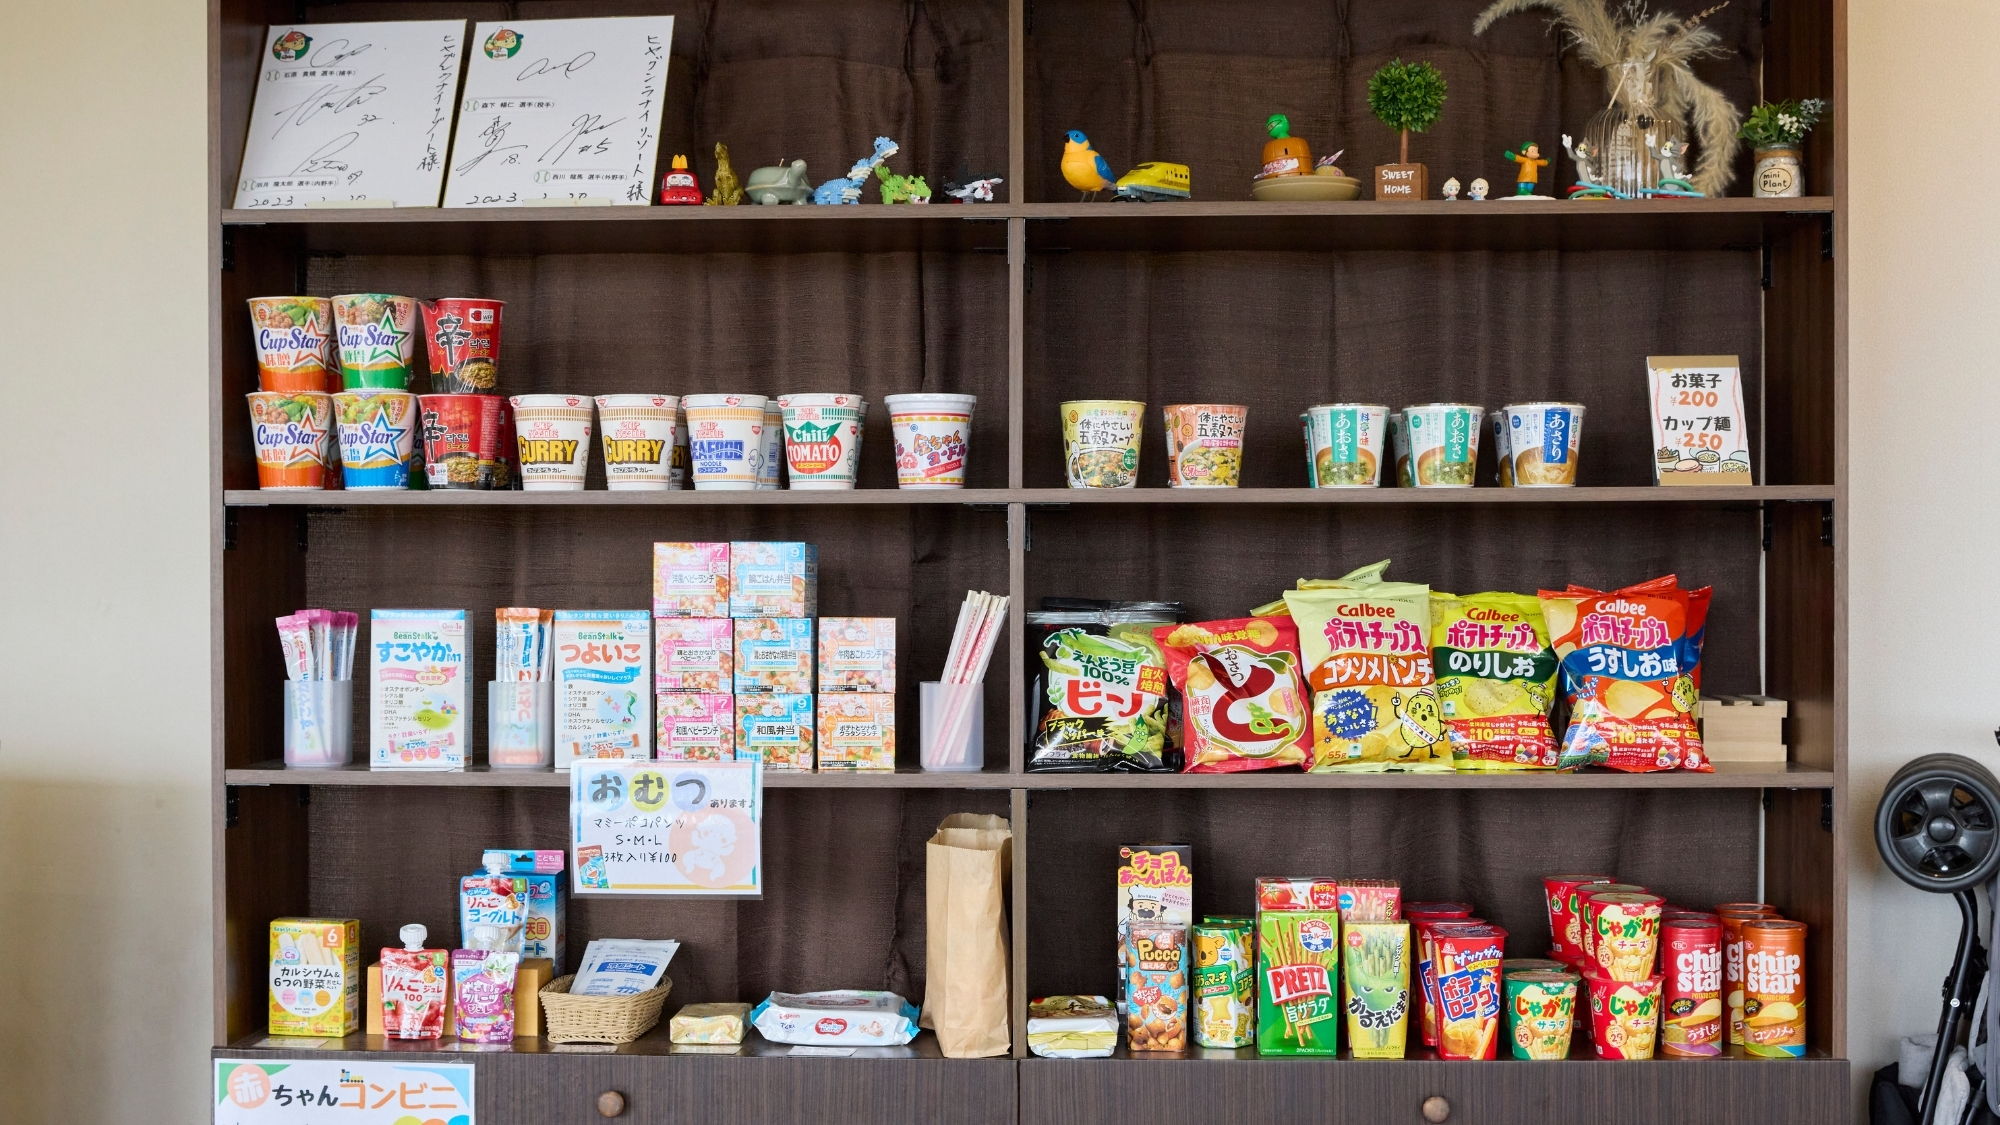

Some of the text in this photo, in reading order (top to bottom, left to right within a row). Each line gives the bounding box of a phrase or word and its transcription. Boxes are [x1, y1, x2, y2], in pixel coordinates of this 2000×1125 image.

[1382, 169, 1414, 181] SWEET
[1763, 172, 1781, 180] mini
[1384, 184, 1412, 195] HOME
[1763, 179, 1788, 190] Plant
[260, 327, 321, 352] Cup Star
[340, 325, 398, 349] Cup Star
[435, 312, 473, 367] 辛
[1671, 373, 1722, 388] お菓子
[1670, 391, 1718, 407] ¥200
[1079, 418, 1133, 430] 体にやさしい
[1197, 412, 1244, 424] 体にやさしい
[1663, 416, 1731, 431] カップ麺
[257, 423, 318, 447] Cup Star
[358, 423, 393, 445] Star
[423, 408, 448, 461] 辛
[792, 426, 830, 443] Chili
[1079, 431, 1134, 446] 五穀スープ
[1335, 412, 1352, 460] あおさ
[1449, 412, 1465, 459] あおさ
[1550, 413, 1565, 461] あさり
[1675, 432, 1723, 450] ¥250
[518, 435, 579, 464] CURRY
[604, 435, 665, 464] CURRY
[690, 435, 744, 462] SEAFOOD
[788, 443, 839, 462] TOMATO
[714, 547, 724, 557] 7
[791, 547, 799, 558] 9
[1337, 603, 1395, 618] Calbee
[1467, 608, 1519, 622] Calbee
[1595, 600, 1646, 616] Calbee
[393, 631, 432, 640] BeanStalk
[578, 631, 617, 640] BeanStalk
[717, 623, 727, 633] 7
[796, 623, 806, 633] 9
[878, 623, 893, 633] 12
[1322, 617, 1428, 654] ポテトチップス
[1581, 614, 1672, 649] ポテトチップス
[1447, 620, 1540, 653] ポテトチップス
[560, 642, 641, 664] つよいこ
[1072, 650, 1136, 675] えんどう豆
[1224, 648, 1244, 681] おさつ
[1323, 655, 1433, 685] コンソメパンチ
[1449, 652, 1535, 678] のりしお
[1588, 647, 1679, 677] うすしお味
[1081, 665, 1130, 686] 100%
[718, 699, 728, 709] 7
[797, 698, 807, 709] 9
[877, 699, 893, 709] 12
[1067, 680, 1143, 718] ビーノ
[675, 726, 719, 735] 和風ベビーランチ
[756, 725, 795, 735] 和風弁当
[1476, 728, 1494, 741] 10
[1619, 731, 1636, 744] 10
[1328, 751, 1347, 760] 55g
[591, 773, 706, 805] おむつ
[593, 815, 686, 829] マミーポコパンツ
[1133, 853, 1177, 870] チョコ
[467, 897, 501, 909] りんご
[467, 908, 522, 925] ヨーグルト
[327, 928, 338, 943] 6
[1137, 938, 1181, 961] Pucca
[1617, 940, 1649, 950] チーズ
[284, 951, 296, 960] Ca
[1747, 950, 1800, 975] chip
[273, 977, 326, 989] 6つの野菜
[1271, 967, 1327, 998] PRETZ
[1443, 975, 1473, 1001] ポテ
[1747, 970, 1801, 994] star
[404, 993, 423, 1002] 100
[1447, 984, 1493, 1019] ロング
[1757, 993, 1774, 1001] POTATO
[1286, 997, 1330, 1023] 旨サラダ
[1348, 990, 1407, 1029] かるえだまめ
[1537, 1020, 1567, 1030] サラダ
[1518, 1033, 1529, 1043] 29
[1611, 1033, 1623, 1043] 29
[234, 1070, 457, 1110] 赤ちゃんコンビニ
